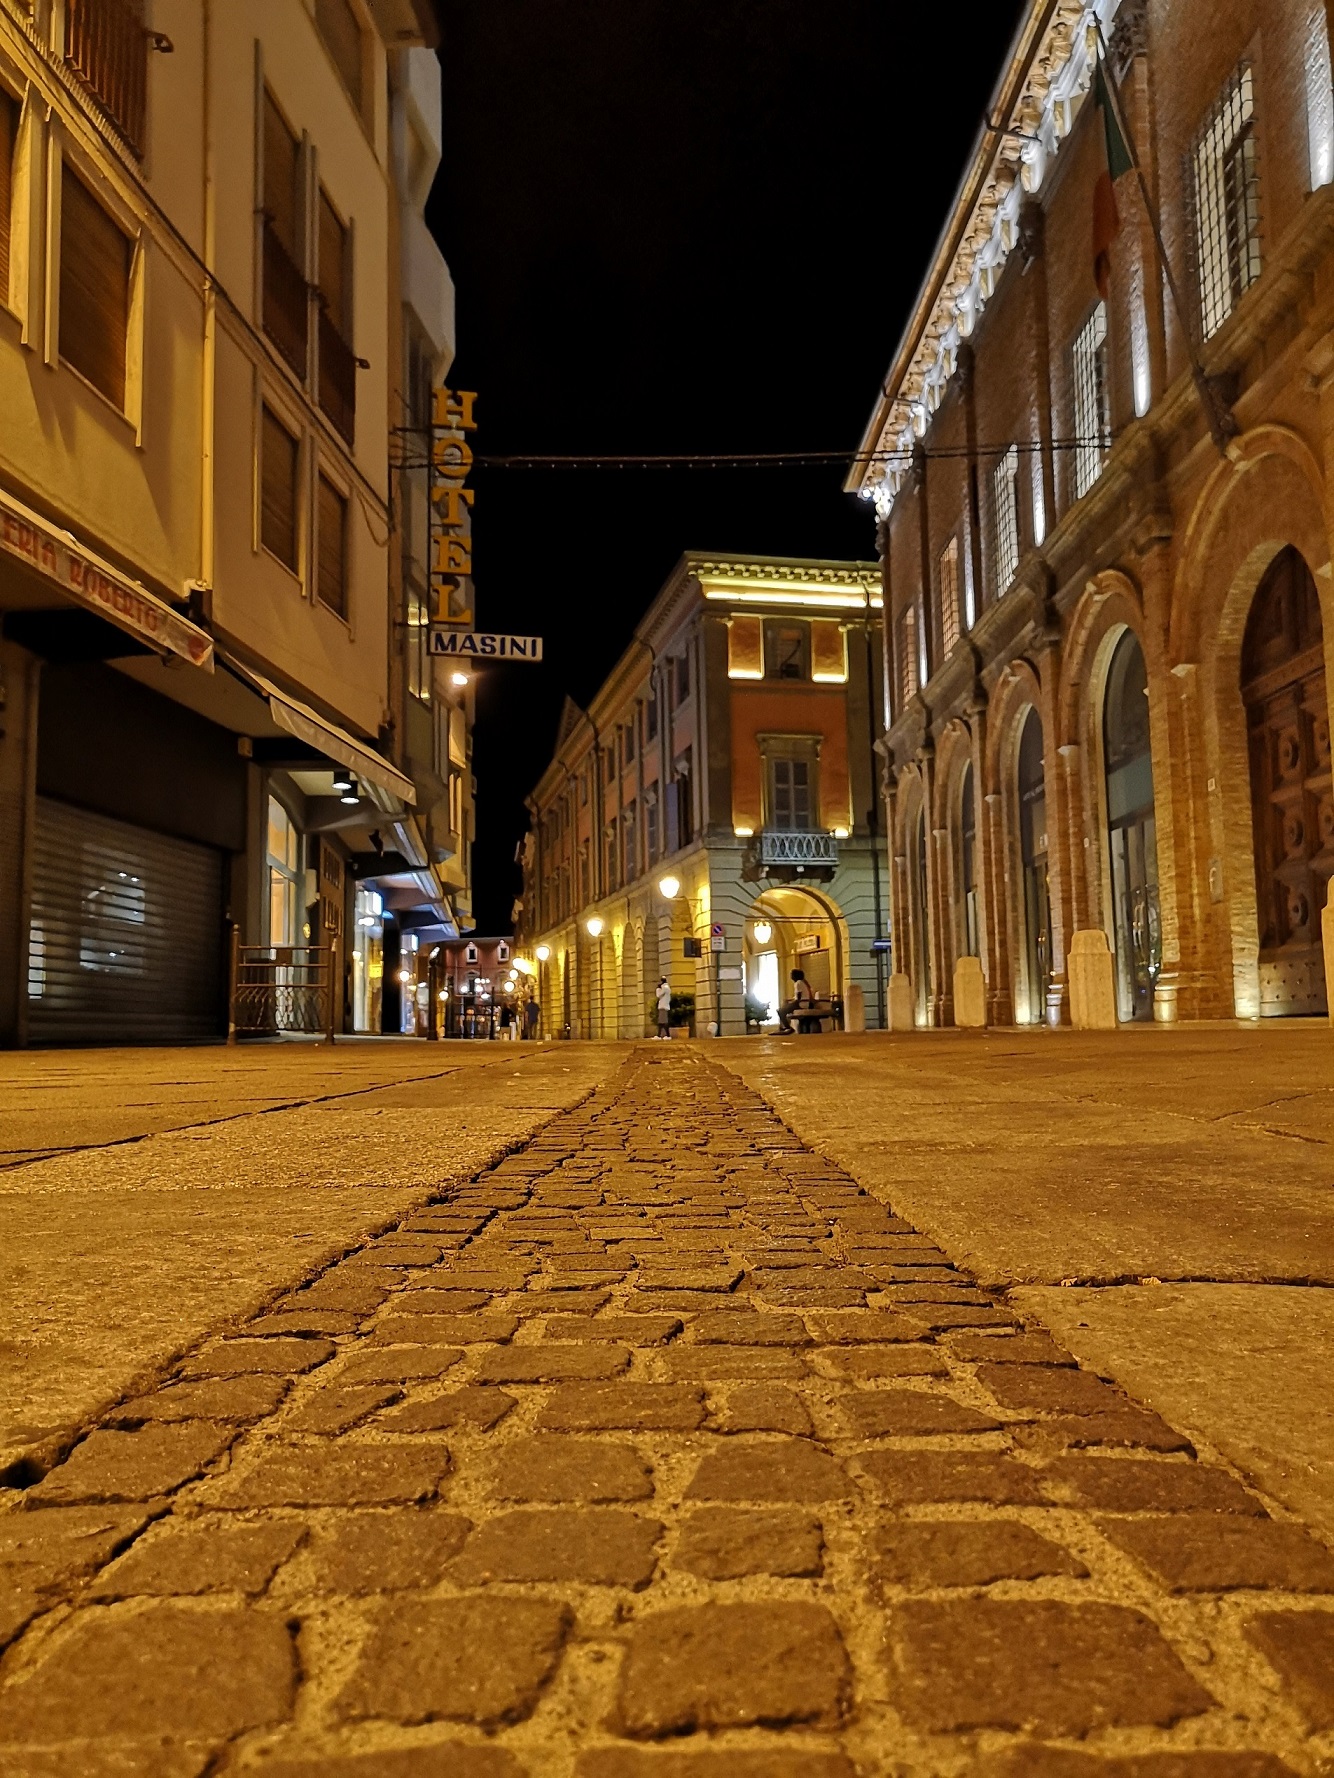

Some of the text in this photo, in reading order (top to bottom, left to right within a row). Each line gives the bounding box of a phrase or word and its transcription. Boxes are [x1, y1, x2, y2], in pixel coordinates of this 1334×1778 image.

[432, 387, 478, 625] HOTEL
[69, 554, 159, 632] ROBERTO
[433, 632, 538, 658] MASINI
